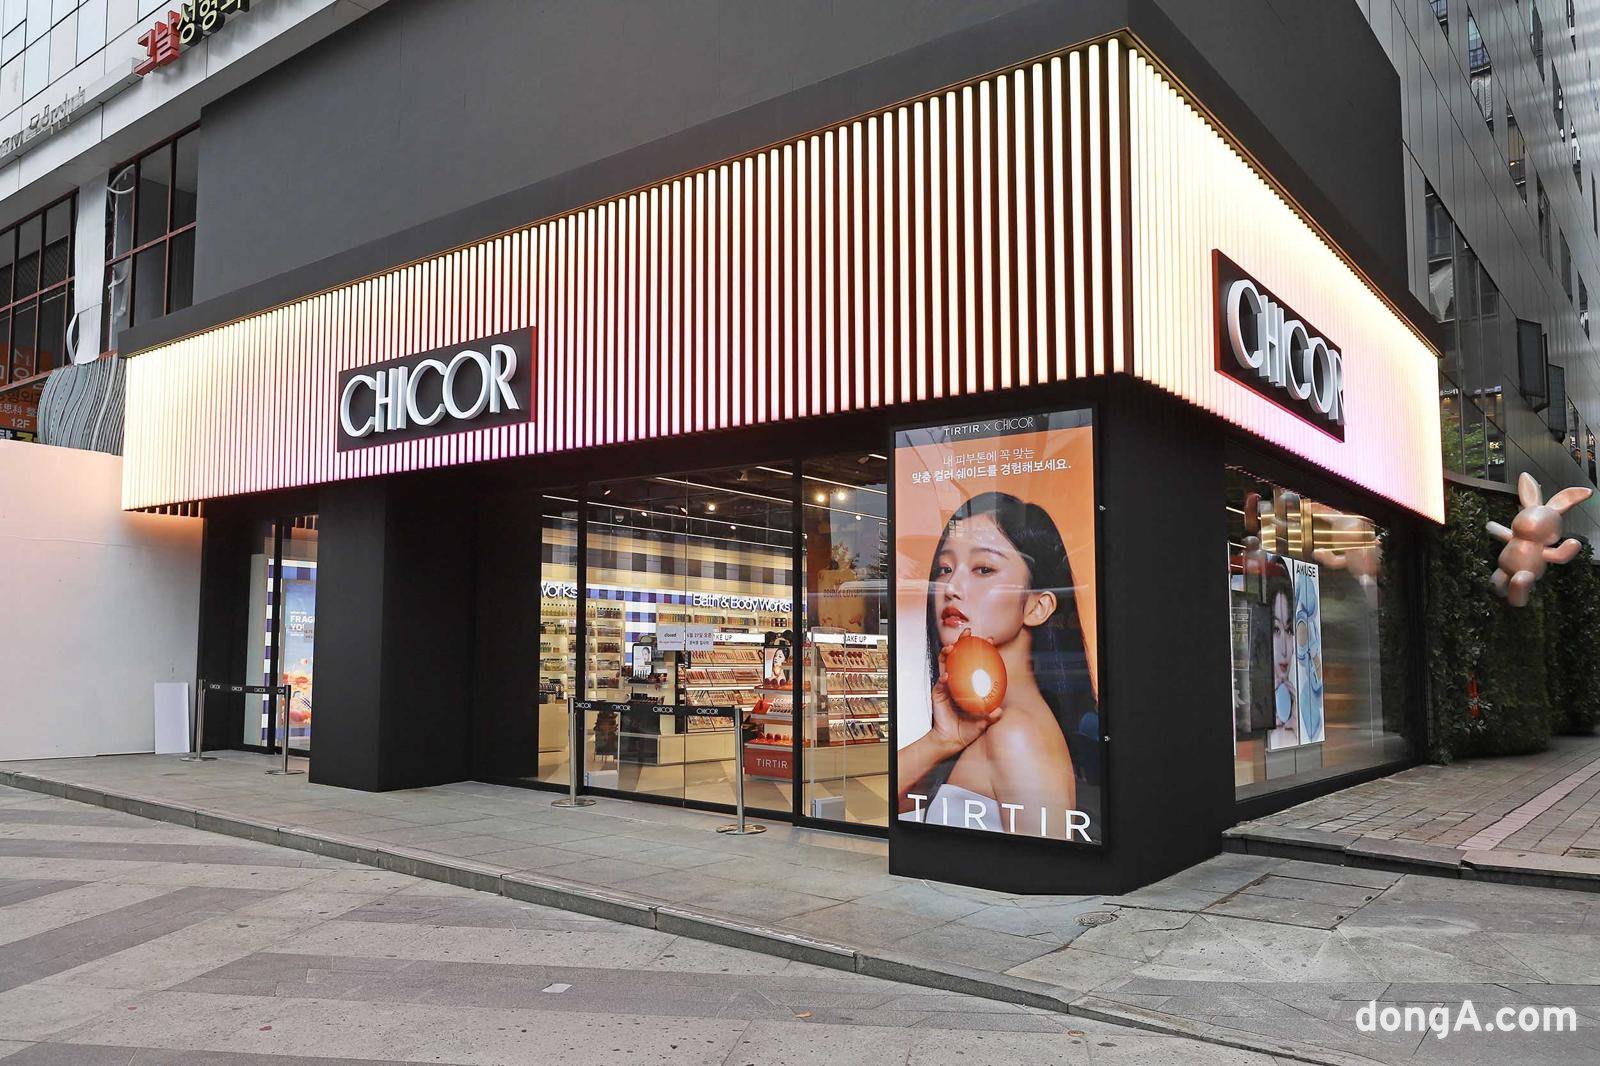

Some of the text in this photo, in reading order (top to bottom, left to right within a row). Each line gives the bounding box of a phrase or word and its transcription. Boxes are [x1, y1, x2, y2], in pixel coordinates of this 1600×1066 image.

[1227, 279, 1346, 426] CHICOR
[340, 344, 520, 438] CHICOR
[944, 424, 980, 436] TIRTIR
[995, 416, 1034, 431] CHICOR
[943, 447, 1035, 467] 내 피부톤에 꼭 맞는
[911, 458, 1072, 484] 맞춤 컬러 쉐이드를 경험해보세요.
[1296, 563, 1316, 578] AMUSE
[692, 593, 792, 613] Bath & Body Works
[290, 615, 315, 623] FRAG
[756, 758, 788, 769] TIRTIR
[907, 793, 1092, 842] TIRTIR
